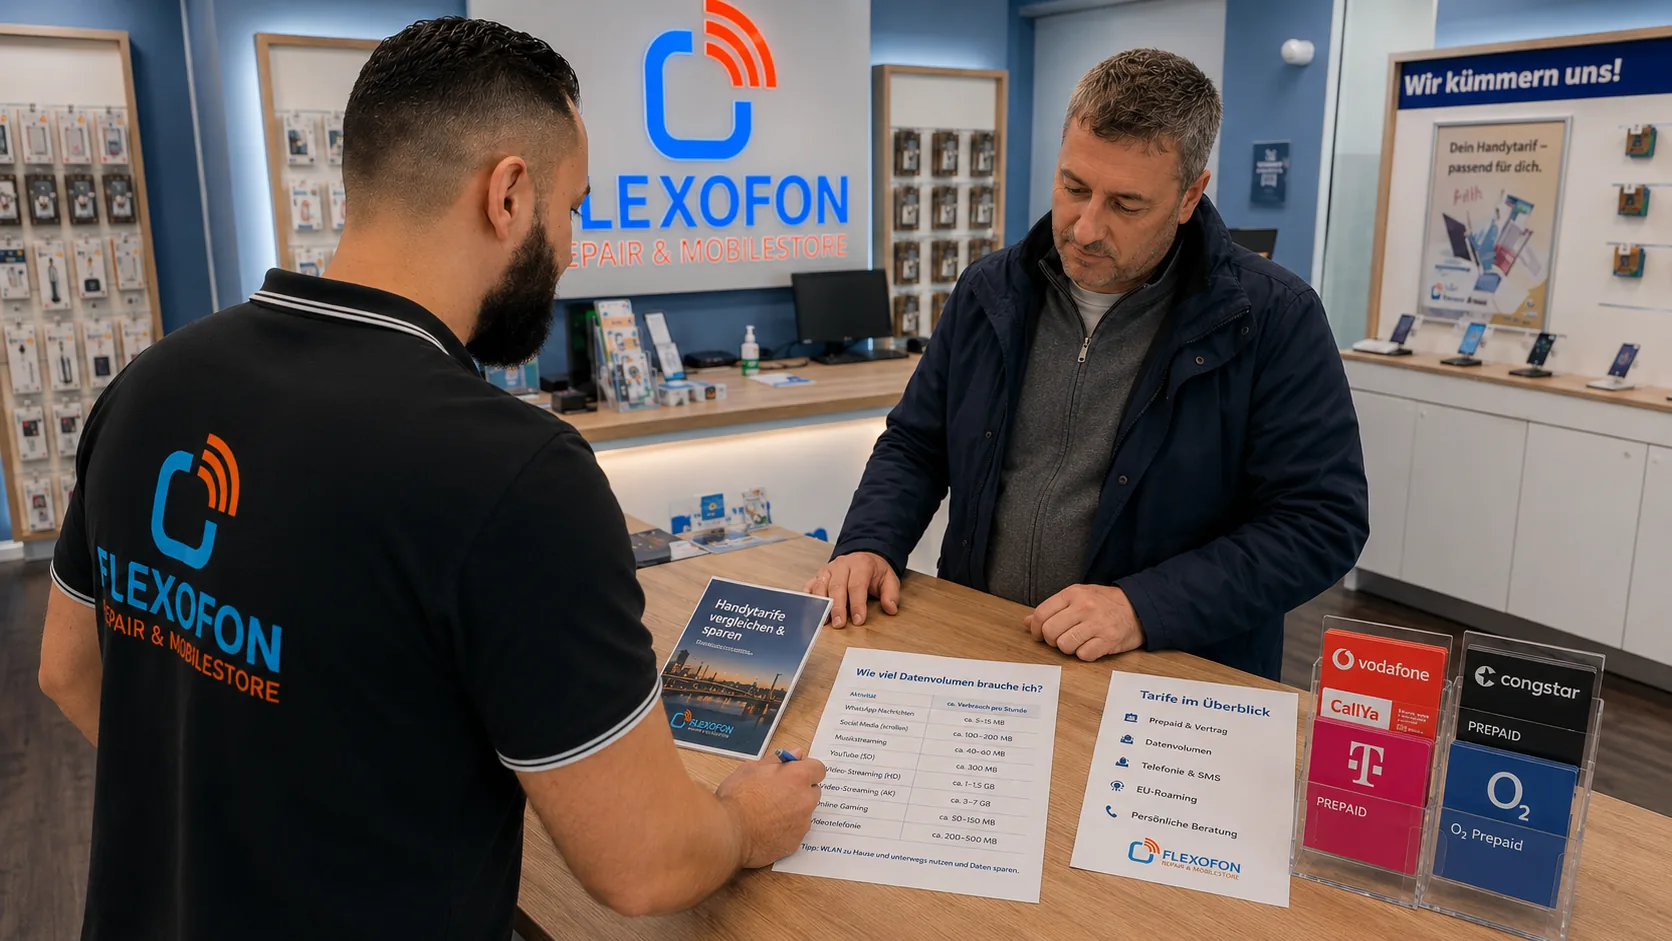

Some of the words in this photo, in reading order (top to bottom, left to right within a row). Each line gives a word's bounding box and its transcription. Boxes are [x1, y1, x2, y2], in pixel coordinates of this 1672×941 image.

[1405, 72, 1443, 96] Wir
[1445, 68, 1559, 94] kümmern
[1564, 58, 1623, 85] uns!
[1449, 142, 1474, 153] Dein
[1477, 140, 1537, 155] Handytarif
[1448, 161, 1493, 175] passend
[1495, 161, 1511, 173] für
[1514, 160, 1542, 173] dich.
[581, 175, 848, 230] LEXOFON
[653, 240, 671, 265] &
[681, 234, 848, 264] MOBILESTORE
[97, 546, 282, 673] FLEXOFON
[715, 599, 786, 622] Handytarife
[702, 625, 742, 641] sparen
[709, 613, 774, 634] vergleichen
[775, 626, 785, 636] &
[151, 625, 164, 646] &
[169, 631, 280, 703] MOBILESTORE
[1358, 658, 1430, 682] vodafone
[856, 668, 876, 678] Wie
[878, 670, 897, 680] viel
[899, 672, 974, 687] Datenvolumen
[977, 680, 1019, 691] brauche
[1021, 683, 1043, 693] ich?
[1501, 674, 1580, 699] congstar
[844, 704, 877, 714] WhatsApp
[877, 707, 915, 717] Nachrichten
[1003, 706, 1028, 714] Stunde
[1140, 690, 1178, 704] Tarife
[1182, 695, 1199, 707] im
[1202, 697, 1271, 718] Überblick
[1330, 699, 1379, 721] CallYa
[839, 719, 859, 727] Social
[859, 720, 879, 729] Media
[1149, 717, 1183, 729] Prepaid
[1194, 723, 1228, 736] Vertrag
[1468, 720, 1521, 742] PREPAID
[834, 734, 888, 747] Musikstreaming
[1145, 738, 1212, 756] Datenvolumen
[829, 750, 859, 759] YouTube
[1141, 761, 1185, 776] Telefonie
[1187, 770, 1195, 778] &
[1198, 771, 1221, 782] SMS
[979, 800, 991, 808] GB
[1136, 785, 1198, 805] EU-Roaming
[839, 802, 869, 814] Gaming
[1316, 796, 1367, 817] PREPAID
[982, 818, 996, 826] MB
[1131, 811, 1189, 829] Persönliche
[1191, 822, 1238, 840] Beratung
[983, 837, 998, 845] MB
[1471, 828, 1524, 851] Prepaid
[801, 843, 819, 852] Tipp:
[820, 845, 842, 854] WLAN
[852, 849, 875, 858] Hause
[875, 852, 890, 860] und
[890, 854, 928, 865] unterwegs
[928, 858, 954, 867] nutzen
[954, 861, 969, 869] und
[969, 862, 992, 871] Daten
[992, 866, 1020, 875] sparen.
[1162, 850, 1241, 874] FLEXOFON
